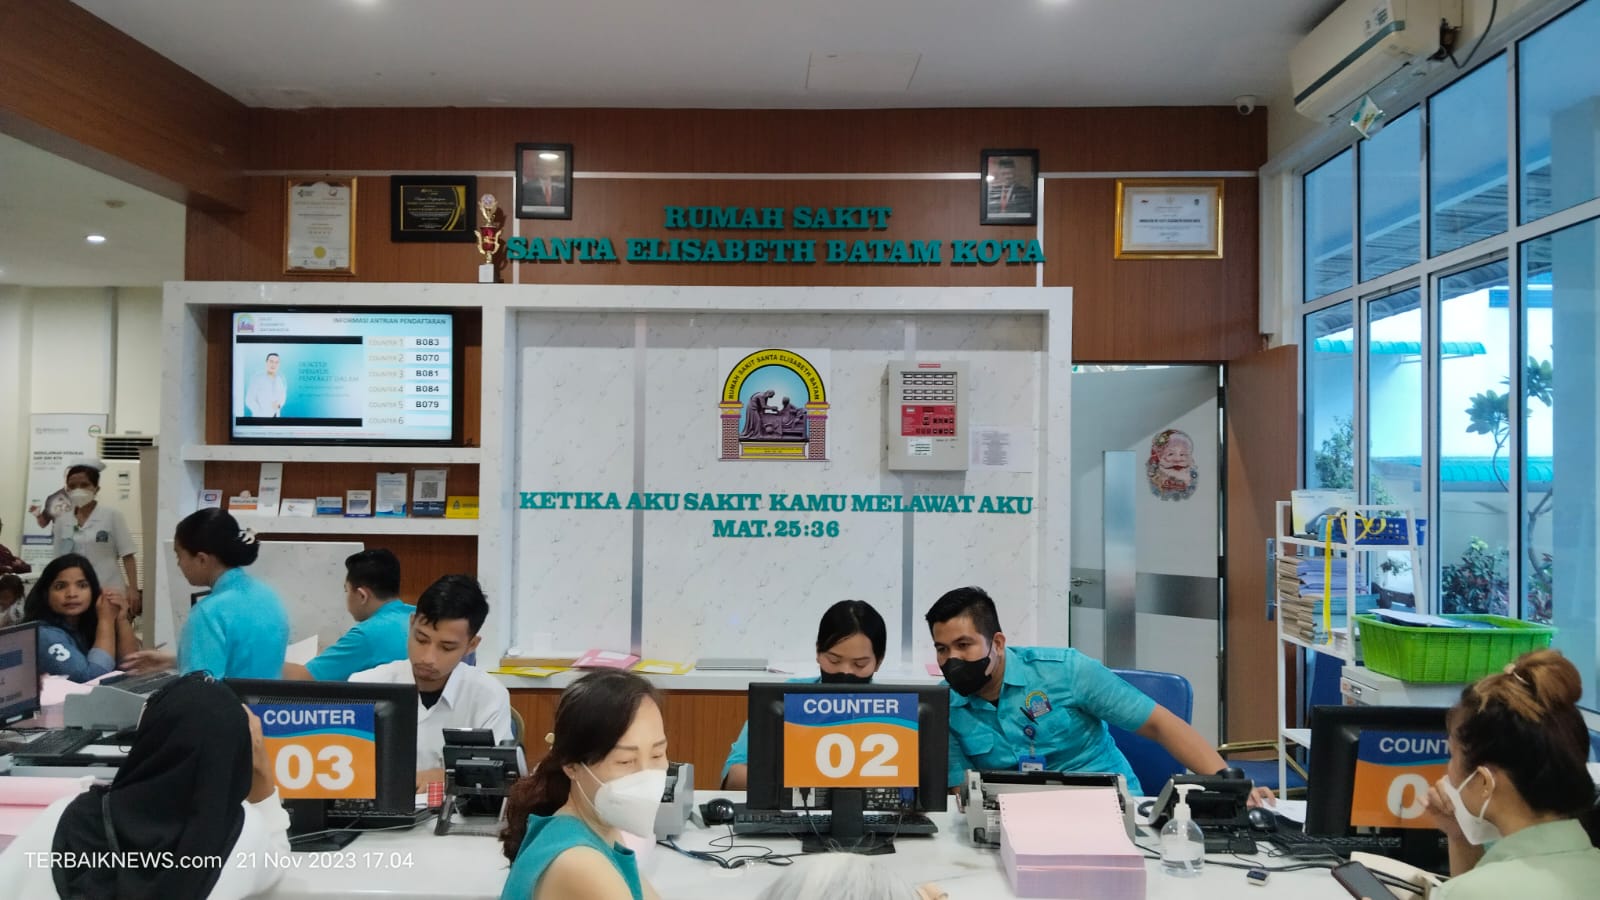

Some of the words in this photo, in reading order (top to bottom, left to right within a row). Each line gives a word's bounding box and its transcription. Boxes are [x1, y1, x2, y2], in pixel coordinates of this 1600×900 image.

[664, 206, 785, 230] RUMAH
[792, 206, 893, 230] SAKIT
[506, 237, 617, 262] SANTA
[625, 238, 816, 264] ELISABETH
[826, 239, 942, 264] BATAM
[952, 239, 1046, 264] KOTA
[415, 338, 440, 346] B083
[415, 354, 440, 362] B070
[728, 374, 740, 400] RUMAH
[738, 359, 756, 376] SAKIT
[756, 354, 778, 362] SANTA
[809, 376, 820, 400] BATAM
[519, 491, 622, 511] KETIKA
[625, 492, 681, 511] AKU
[683, 492, 762, 512] SAKIT
[769, 493, 848, 513] KAMU
[851, 494, 976, 514] MELAWAT
[978, 495, 1033, 515] AKU
[712, 519, 840, 538] MAT.25:36
[263, 709, 356, 726] COUNTER
[803, 698, 900, 715] COUNTER
[815, 732, 899, 779] 02
[1379, 737, 1450, 755] COUNT
[274, 743, 355, 791] 03
[1387, 773, 1430, 820] 0
